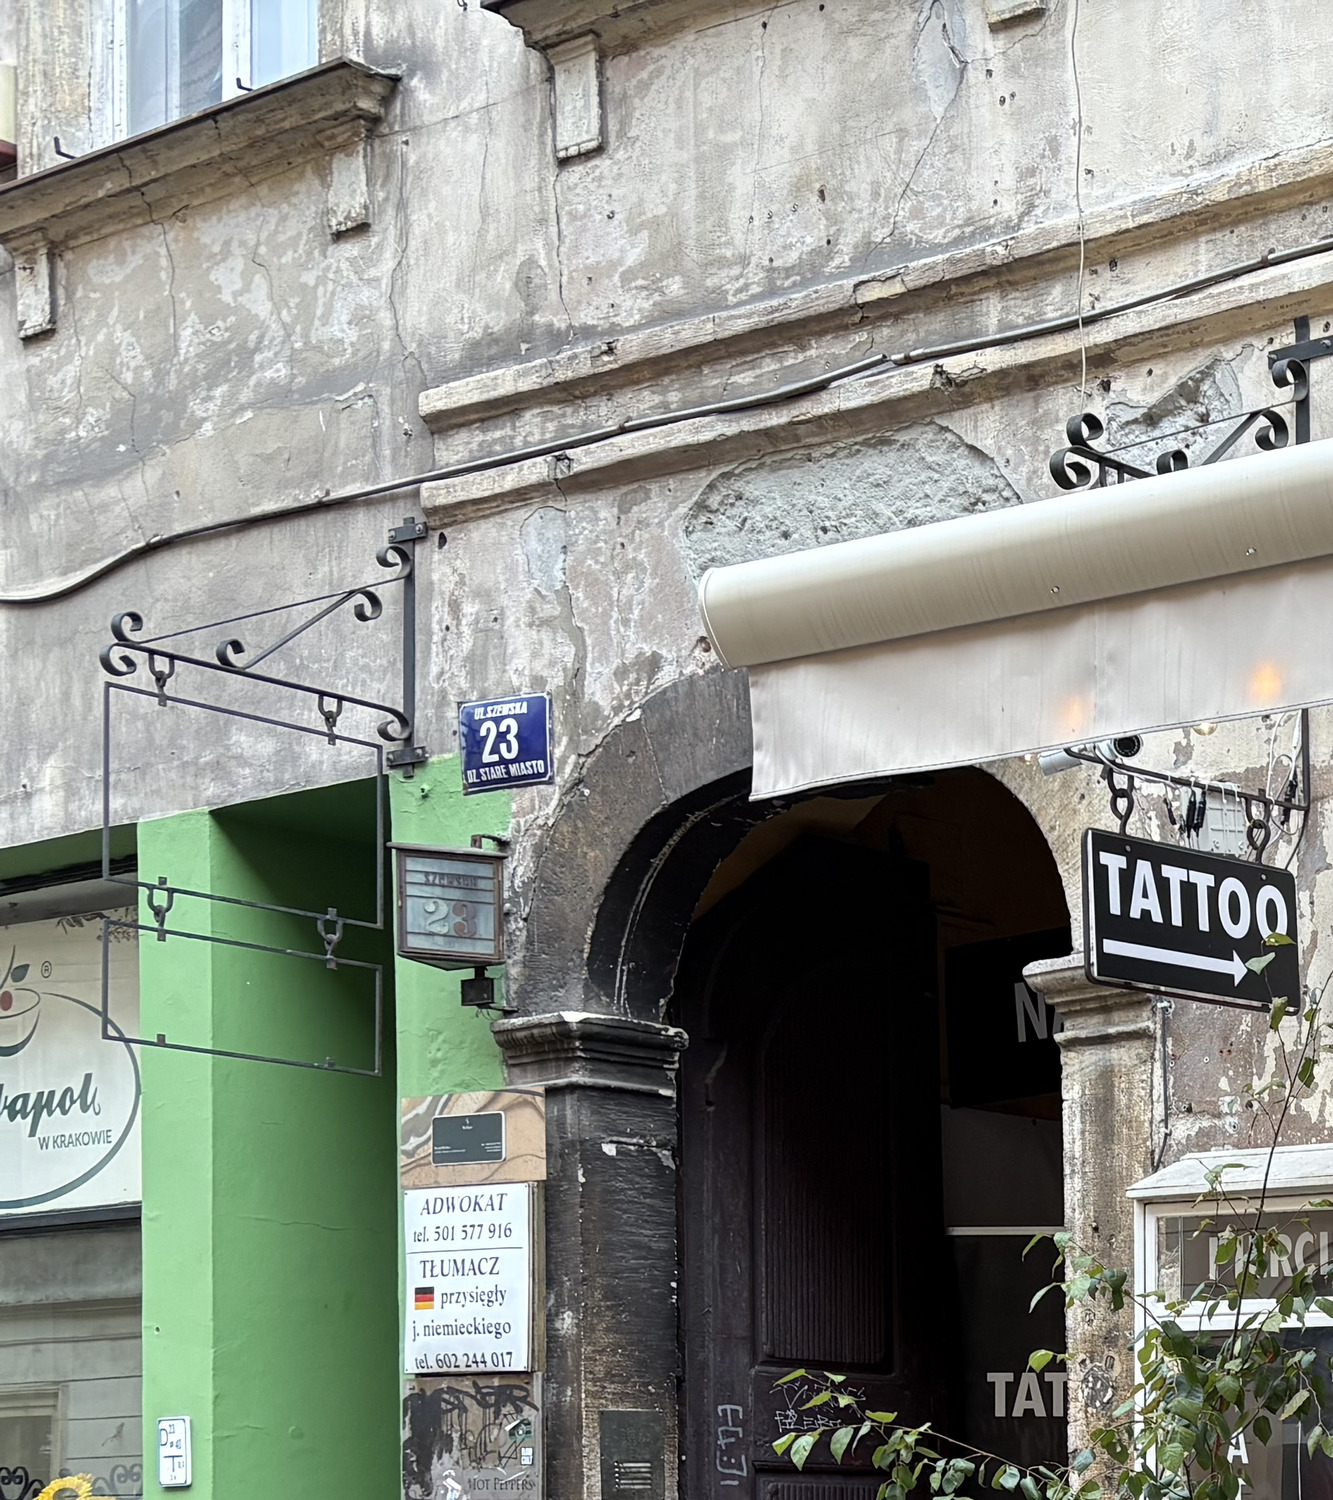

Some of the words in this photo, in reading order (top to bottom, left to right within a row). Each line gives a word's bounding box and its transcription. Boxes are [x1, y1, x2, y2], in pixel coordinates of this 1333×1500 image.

[480, 718, 519, 763] 23
[480, 764, 508, 780] STARE
[508, 760, 545, 777] MIASTO
[1099, 851, 1288, 942] TATTOO
[424, 899, 477, 937] 23
[38, 1135, 50, 1150] W
[53, 1129, 112, 1149] KRAKOWIE
[420, 1193, 508, 1216] ADWOKAT
[413, 1226, 430, 1243] tel.
[434, 1225, 455, 1242] 501
[461, 1223, 483, 1241] 577
[488, 1222, 512, 1239] 916
[420, 1256, 500, 1278] TŁUMACZ
[441, 1284, 507, 1309] przysięgły
[412, 1320, 419, 1342] j.
[423, 1317, 512, 1339] niemieckiego
[414, 1354, 433, 1370] tel.
[435, 1353, 460, 1369] 602
[464, 1352, 487, 1368] 244
[490, 1351, 513, 1368] 017
